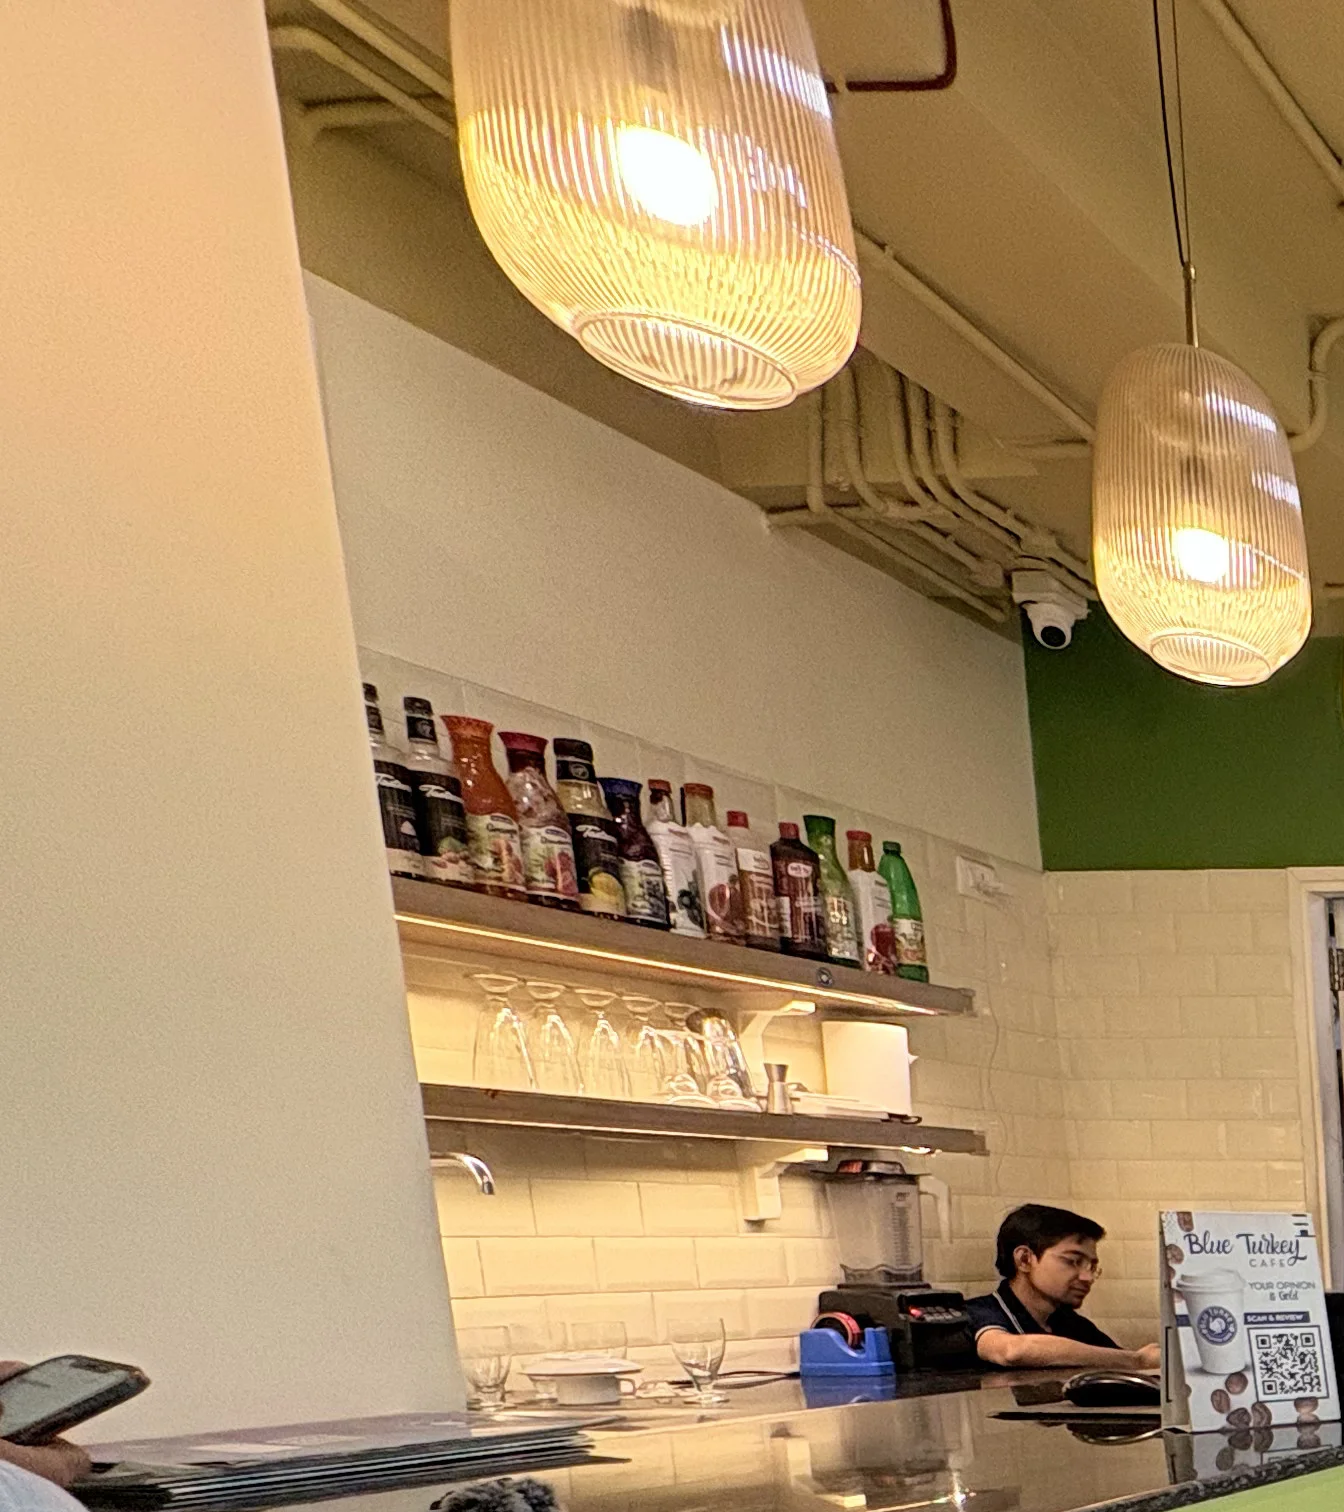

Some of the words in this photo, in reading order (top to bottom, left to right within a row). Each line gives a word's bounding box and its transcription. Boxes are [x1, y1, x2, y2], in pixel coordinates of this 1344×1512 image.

[1183, 1230, 1233, 1254] Blue
[1235, 1232, 1307, 1266] Turkey
[1248, 1281, 1274, 1290] YOUR
[1276, 1280, 1316, 1290] OPINION
[1246, 1314, 1268, 1323] SCAN
[1268, 1314, 1275, 1322] &
[1275, 1313, 1304, 1321] REVIEW
